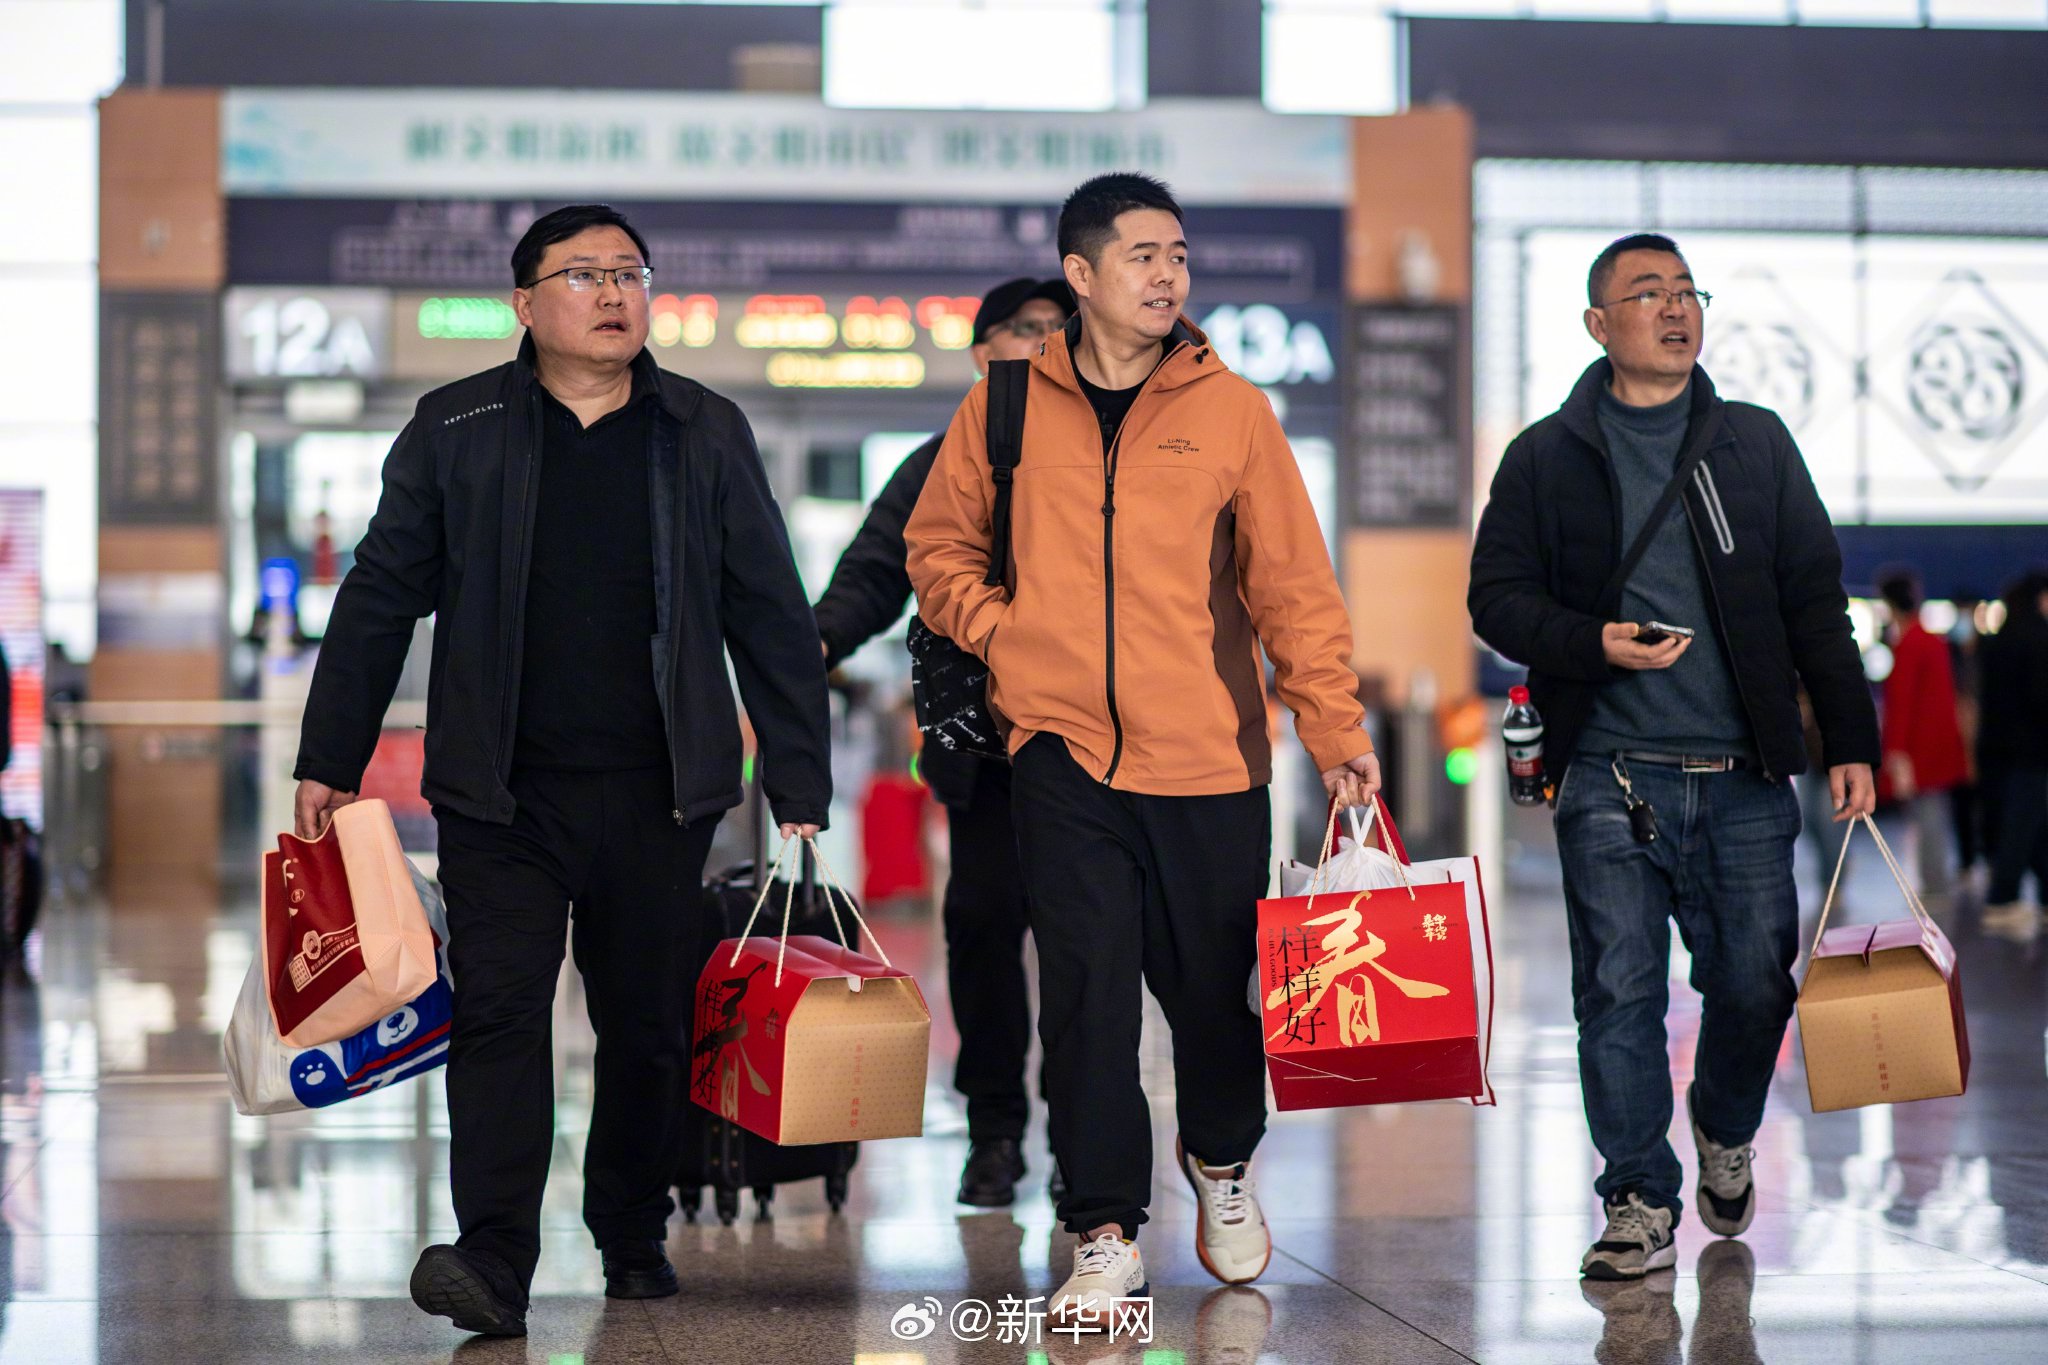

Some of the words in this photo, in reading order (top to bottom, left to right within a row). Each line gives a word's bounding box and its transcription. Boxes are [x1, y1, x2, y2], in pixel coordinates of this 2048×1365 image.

[240, 297, 376, 377] 12A
[1200, 303, 1335, 386] 13A
[444, 403, 504, 425] SEPTWOLVES
[1167, 438, 1191, 446] Li-Ning
[1276, 924, 1327, 1048] 样样好
